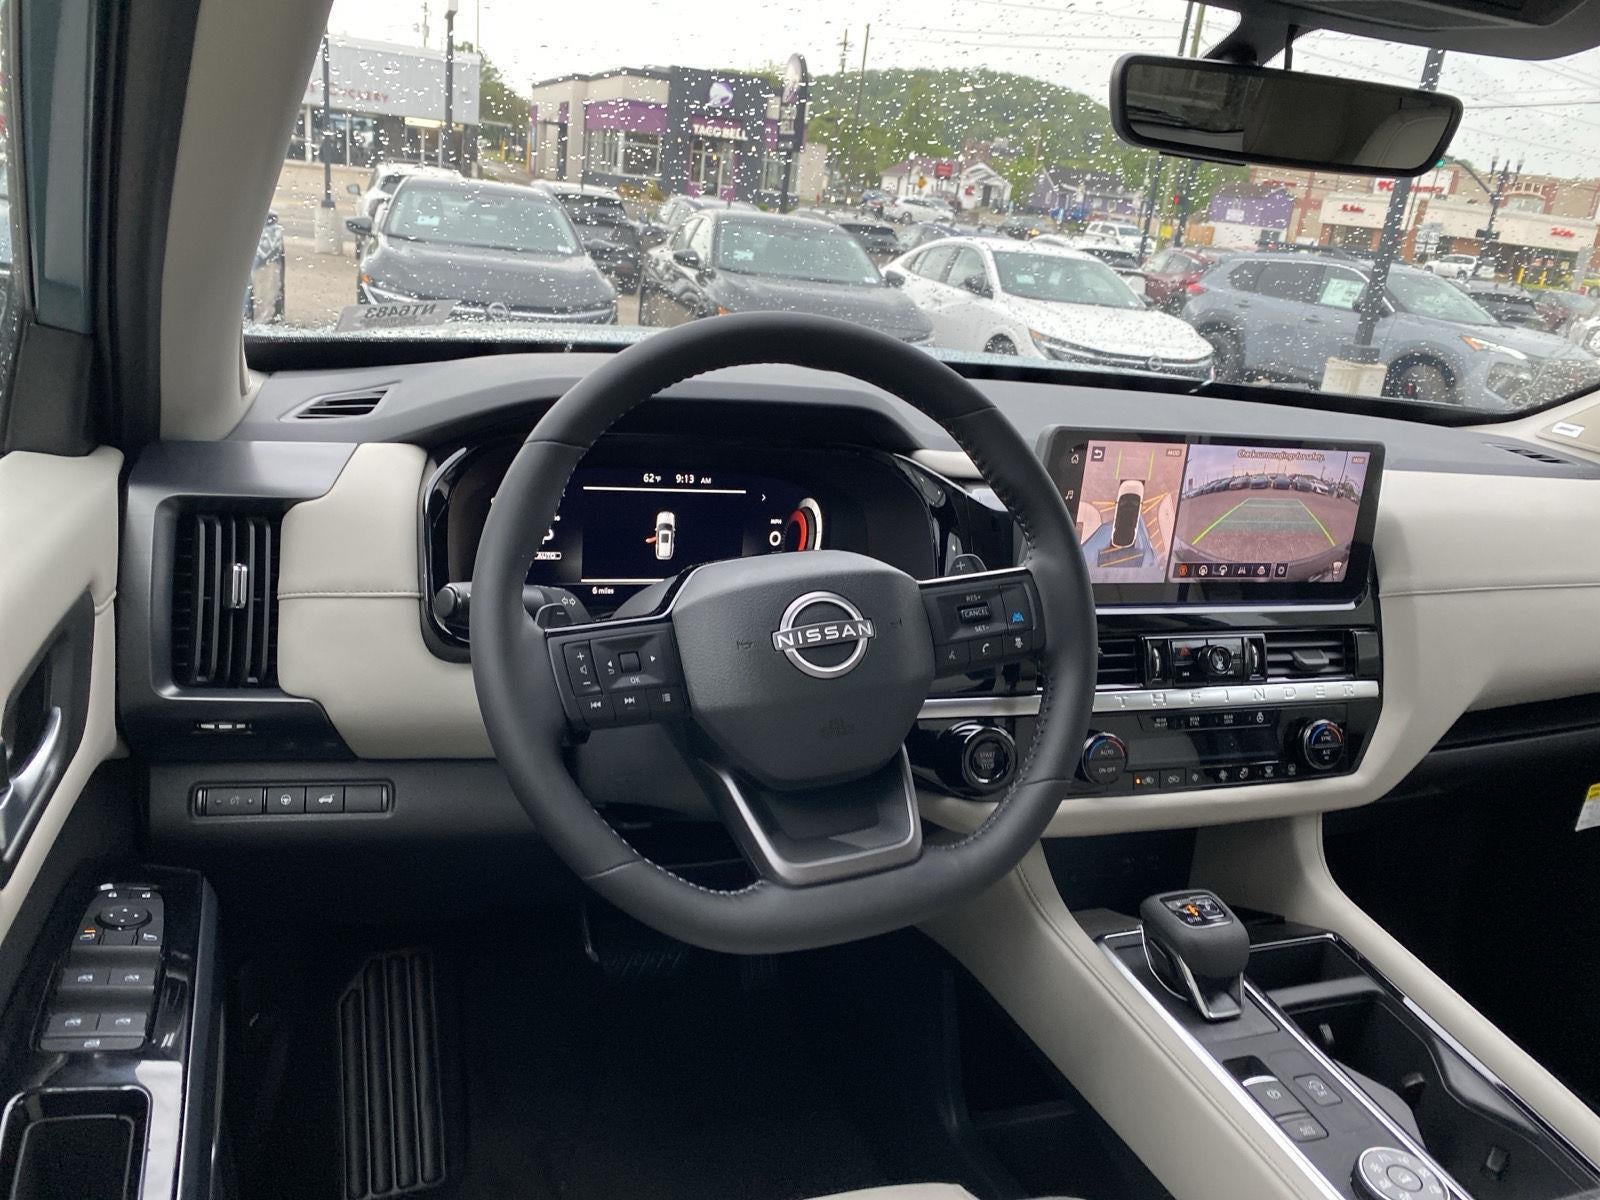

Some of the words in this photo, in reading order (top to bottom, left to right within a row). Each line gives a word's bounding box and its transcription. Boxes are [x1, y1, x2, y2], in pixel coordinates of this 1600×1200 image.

[693, 124, 721, 137] TACO
[721, 127, 748, 141] BELL
[675, 474, 694, 484] 9:13
[769, 531, 781, 546] 0
[592, 586, 598, 595] 6
[599, 587, 614, 595] miles
[964, 607, 988, 618] CANCEL
[777, 622, 873, 648] NISSAN
[630, 676, 640, 684] OK
